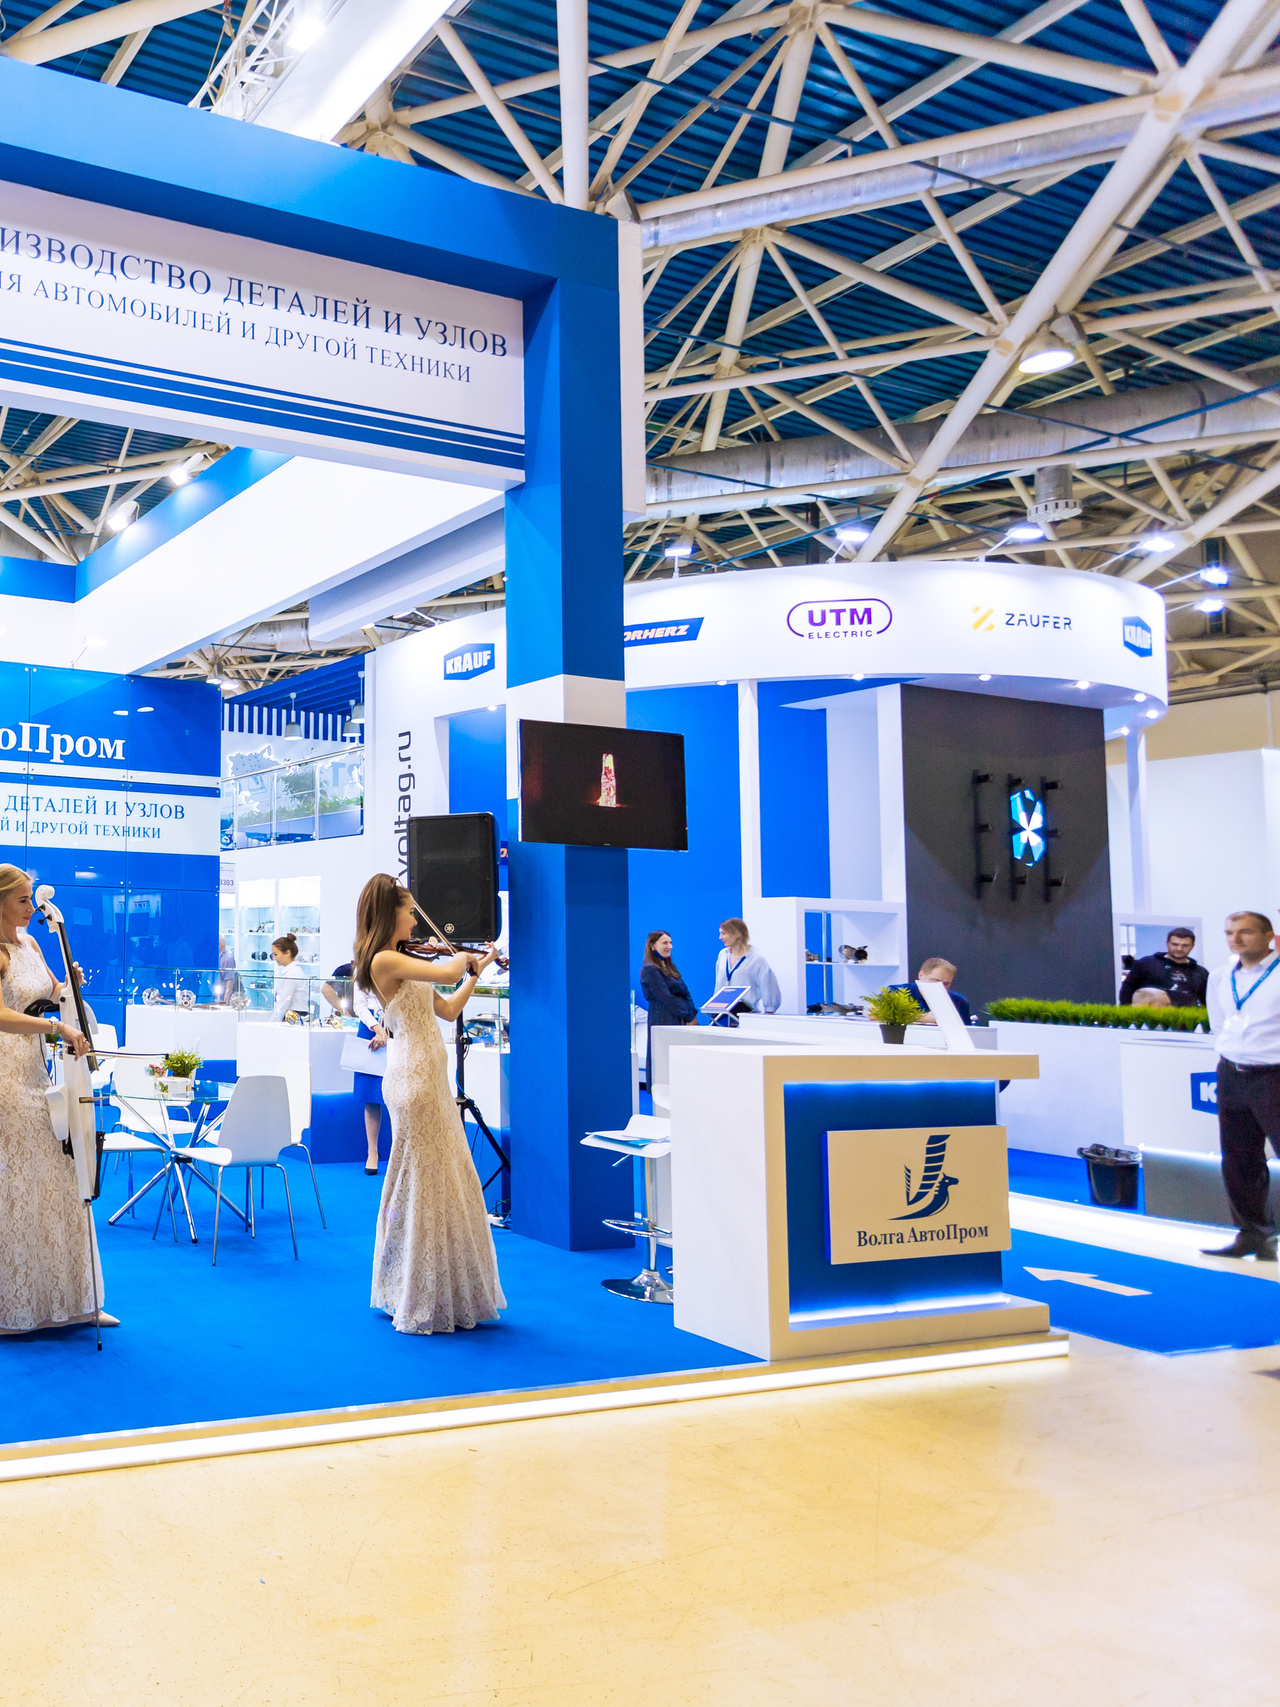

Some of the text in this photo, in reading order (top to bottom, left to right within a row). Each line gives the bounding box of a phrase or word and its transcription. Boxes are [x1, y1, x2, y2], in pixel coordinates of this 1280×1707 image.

[223, 275, 371, 331] ДЕТАЛЕЙ
[383, 311, 403, 336] И
[416, 316, 508, 358] УЗЛОВ
[33, 278, 232, 336] АВТОМОБИЛЕЙ
[242, 321, 256, 340] И
[265, 324, 357, 363] ДРУГОЙ
[366, 344, 472, 383] ТЕХНИКИ
[808, 607, 872, 626] UTM
[624, 625, 690, 641] ORHERZ
[808, 630, 873, 639] ELECTRIC
[446, 650, 491, 675] KRAUF
[5, 791, 98, 815] ДЕТАЛЕЙ
[105, 801, 117, 815] И
[124, 801, 185, 821] УЗЛОВ
[15, 820, 25, 832] И
[30, 820, 87, 838] ДРУГОЙ
[94, 824, 161, 839] ТЕХНИКИ
[857, 1224, 988, 1247] Волга АвтоПром
